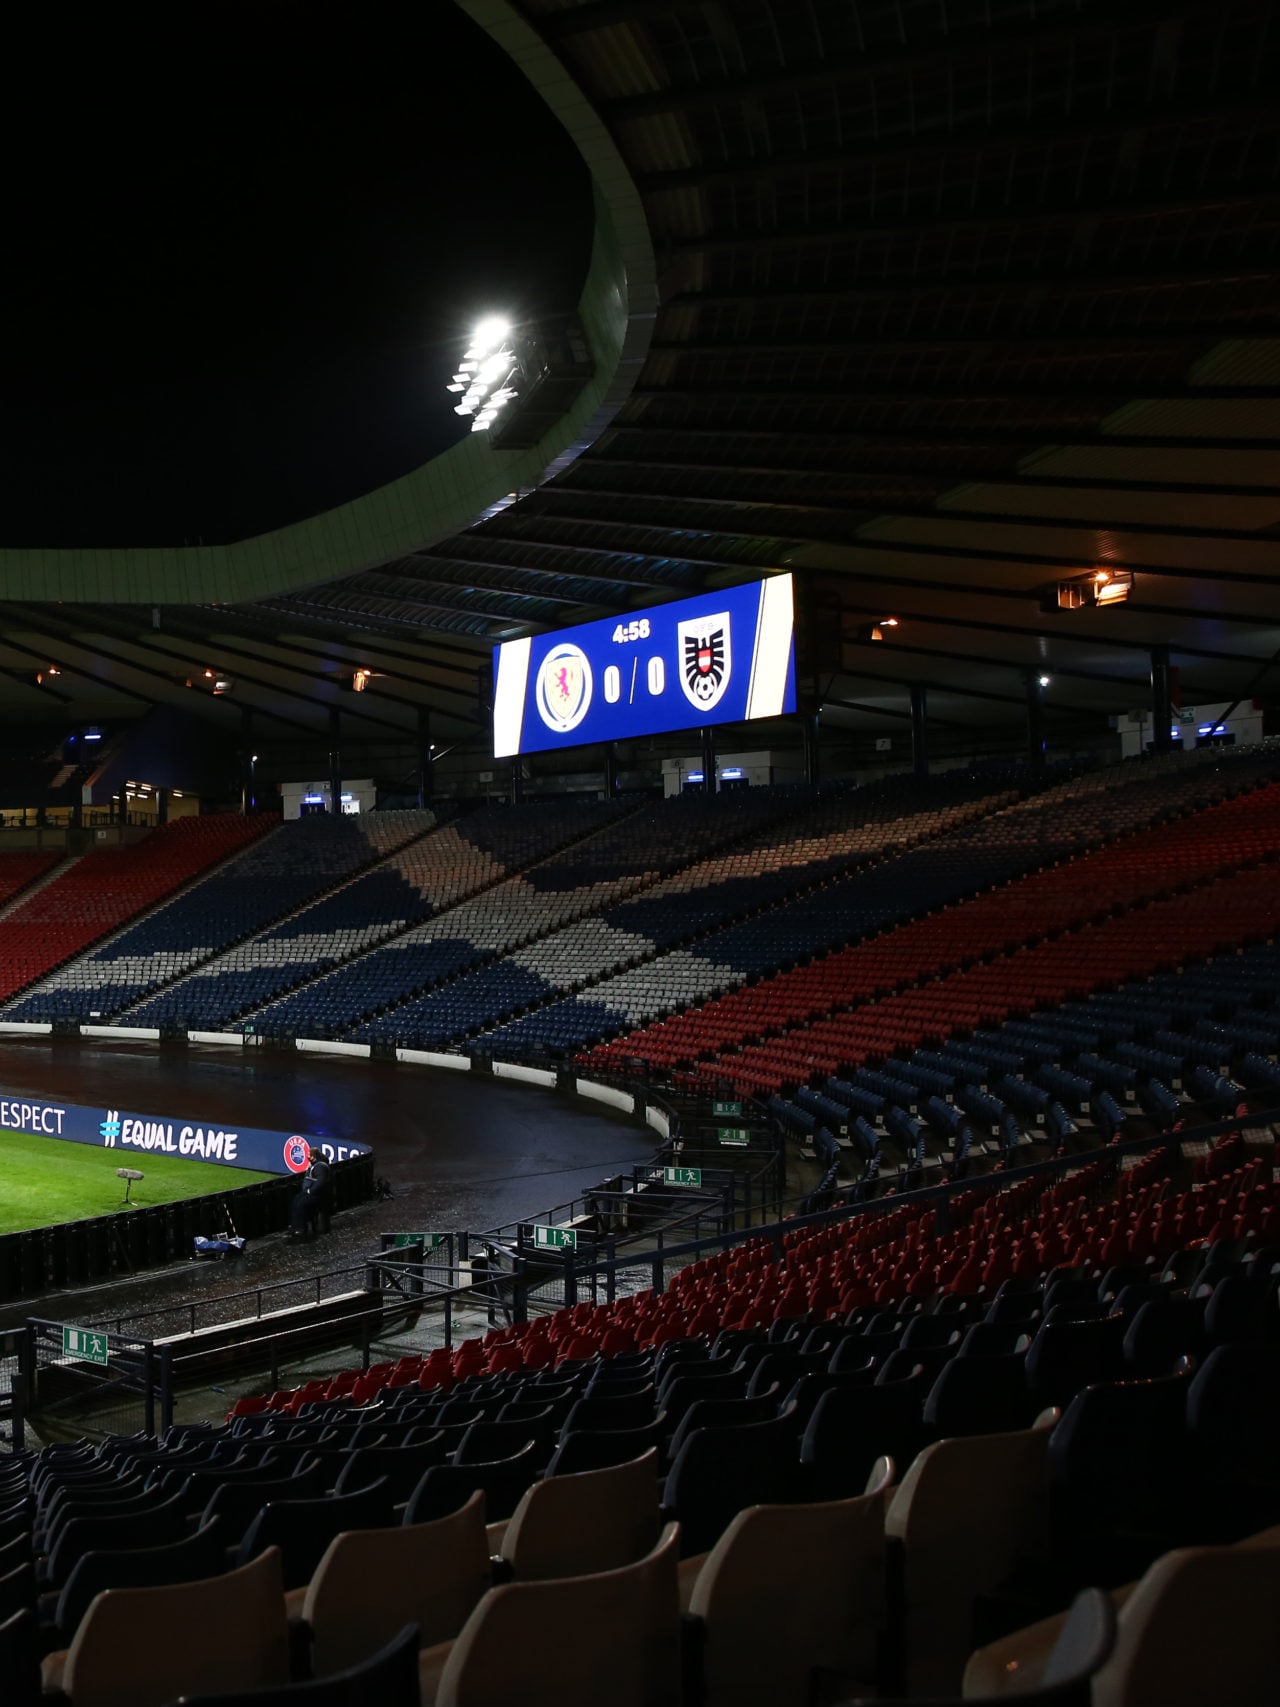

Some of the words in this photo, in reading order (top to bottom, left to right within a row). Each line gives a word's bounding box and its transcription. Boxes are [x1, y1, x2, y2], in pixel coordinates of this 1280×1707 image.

[612, 618, 650, 644] 4:58
[604, 665, 620, 704] 0
[647, 656, 665, 696] 0
[288, 1137, 305, 1147] UEFA
[65, 1349, 93, 1360] EMERGENCY
